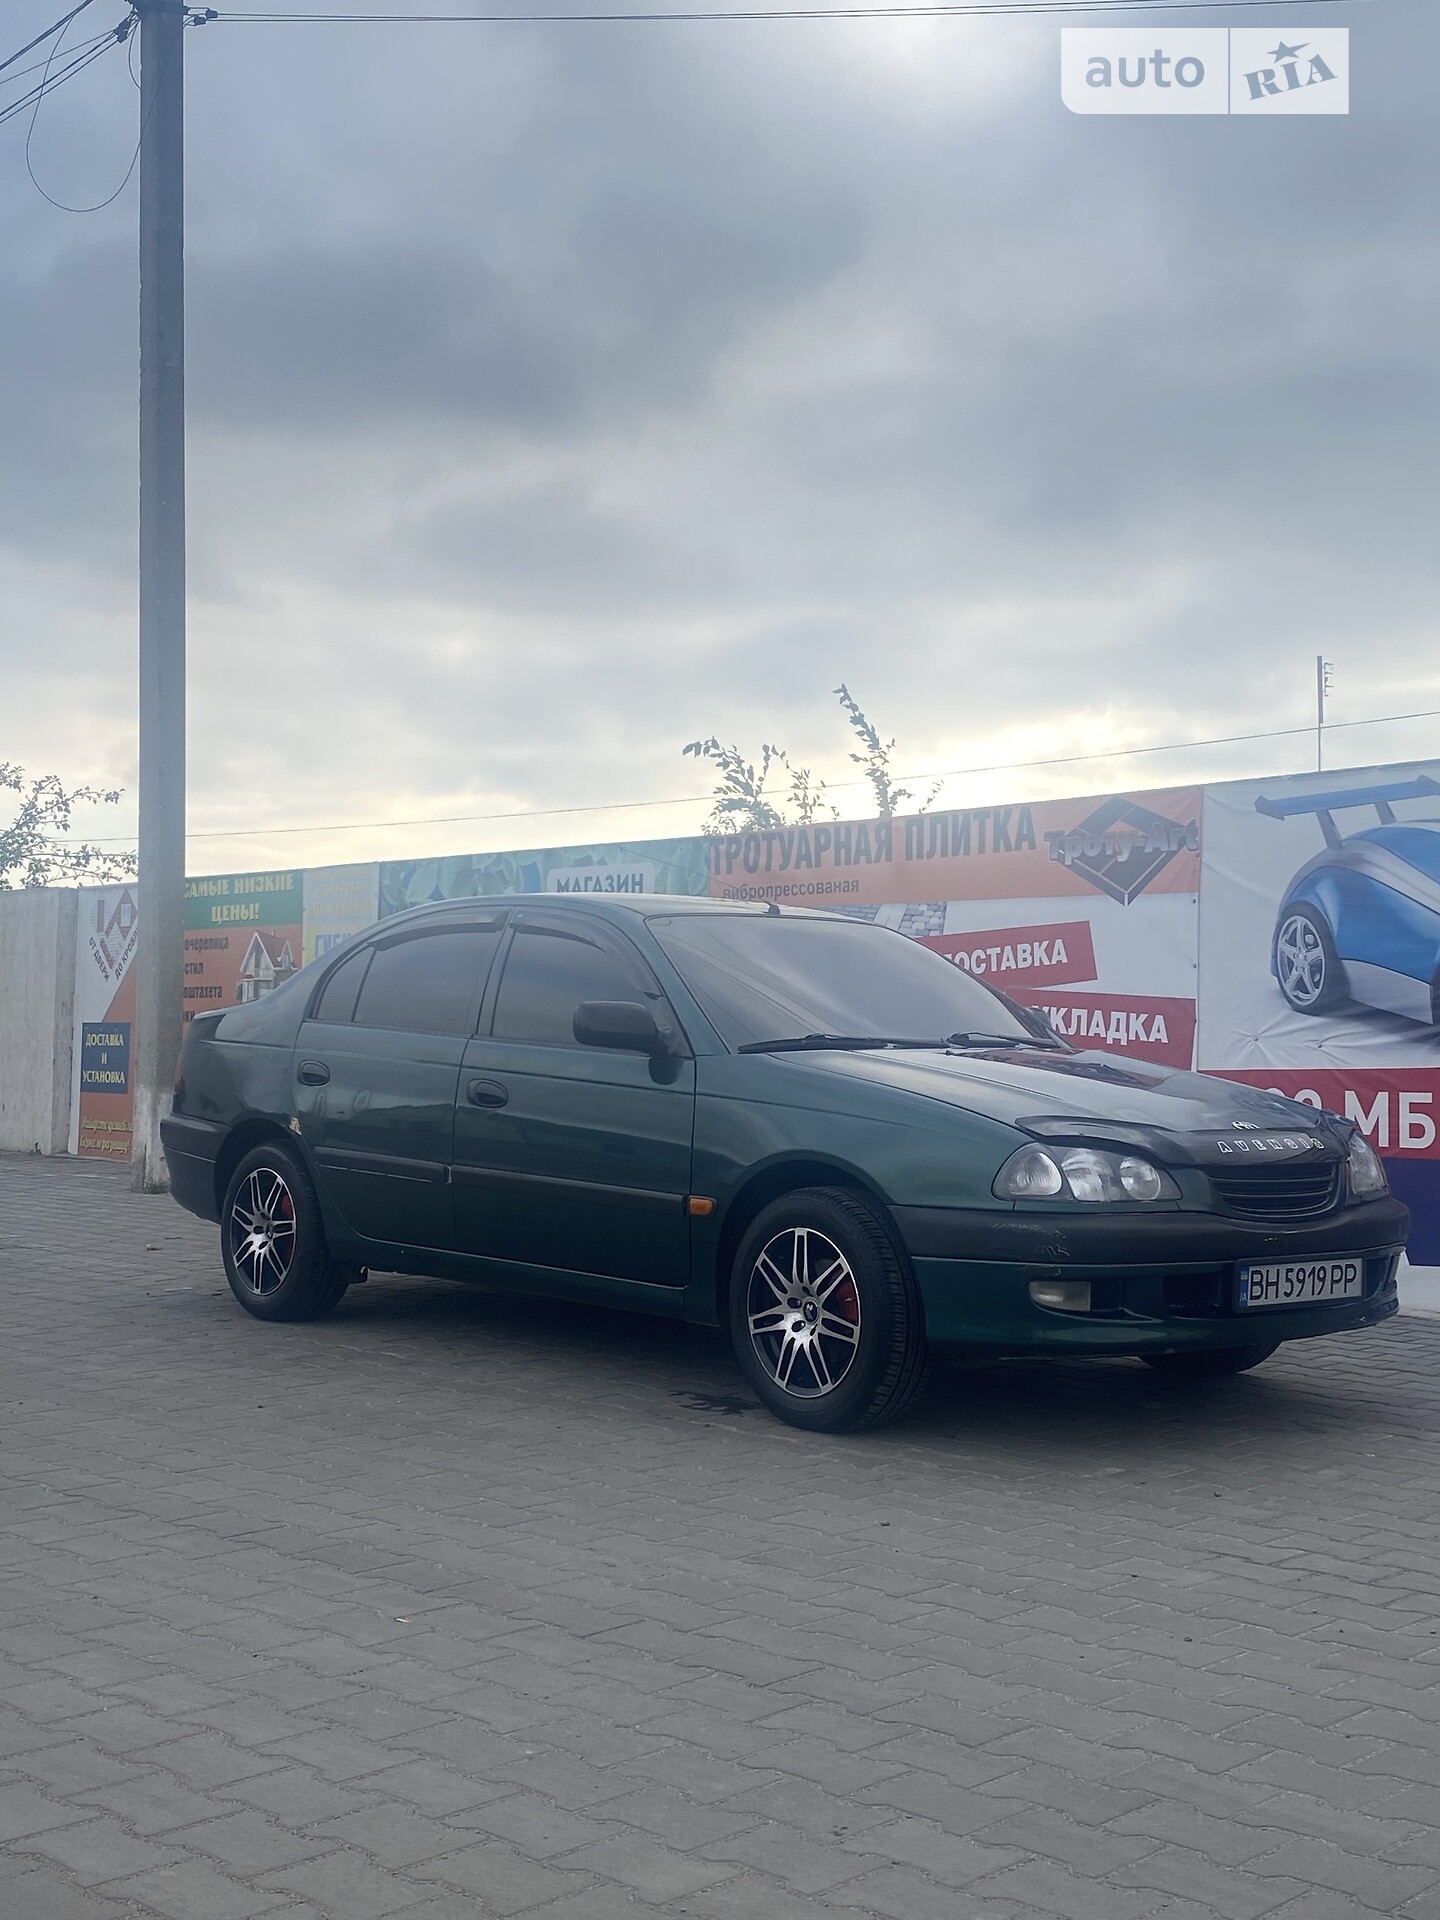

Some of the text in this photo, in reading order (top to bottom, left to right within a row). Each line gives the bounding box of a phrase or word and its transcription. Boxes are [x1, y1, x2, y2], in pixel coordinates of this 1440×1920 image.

[709, 806, 1037, 876] ТРОТУАРНАЯ ПЛИТКА
[234, 873, 295, 894] НИЗКИЕ
[556, 873, 644, 893] МАГАЗИН
[211, 903, 260, 925] ЦЕНЫ!
[122, 928, 139, 965] КРОВЛ
[184, 937, 229, 953] очерепица
[184, 962, 204, 975] стил
[184, 986, 223, 999] оштахета
[1032, 1005, 1169, 1046] КЛАДКА
[85, 1034, 125, 1048] ДОСТАВКА
[101, 1052, 108, 1064] И
[82, 1070, 126, 1084] УСТАНОВКА
[1344, 1090, 1436, 1149] МБ
[1216, 1138, 1325, 1153] AVENSIS
